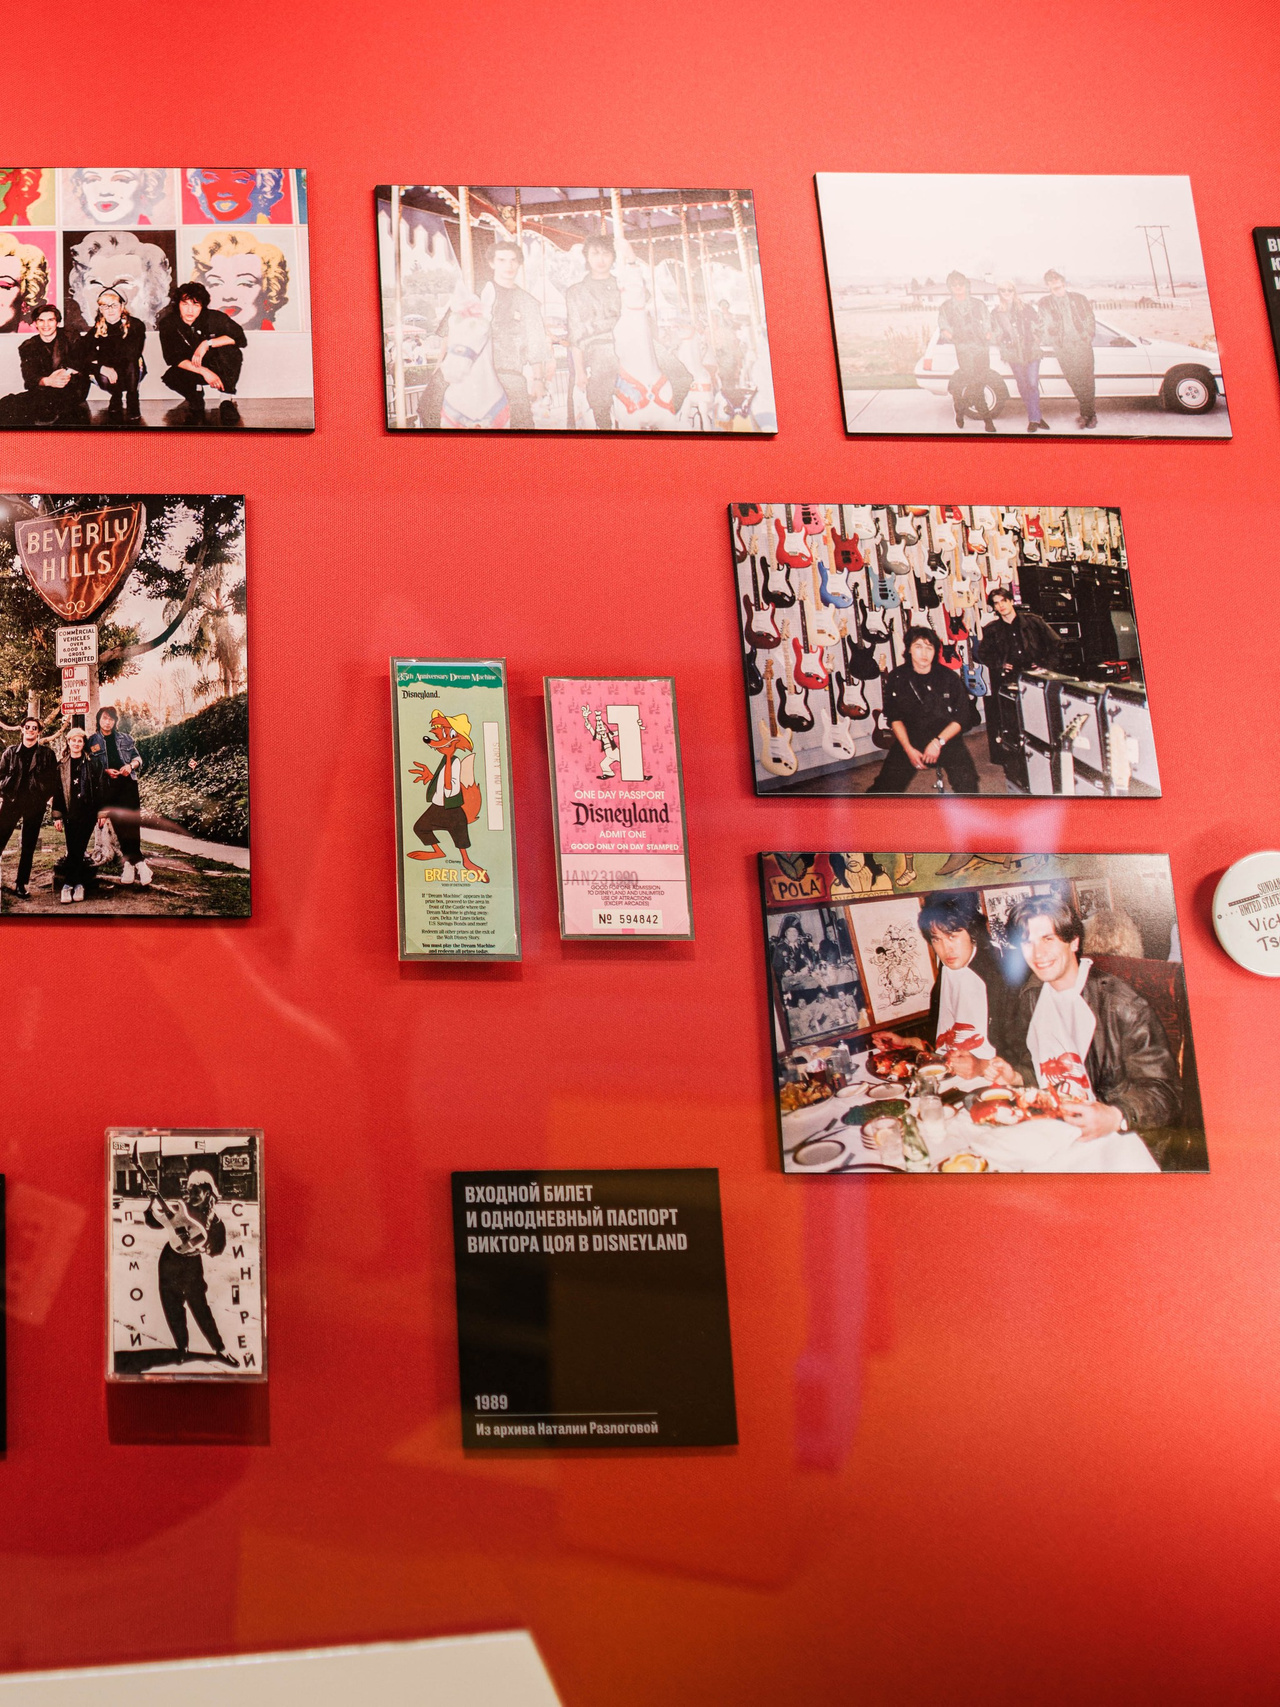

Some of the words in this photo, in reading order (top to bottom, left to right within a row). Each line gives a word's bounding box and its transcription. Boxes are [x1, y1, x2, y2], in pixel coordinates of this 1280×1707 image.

[27, 517, 129, 554] BEVERLY
[42, 550, 112, 582] HILLS
[64, 668, 73, 678] NO
[450, 673, 470, 681] Dream
[64, 680, 87, 688] STOPPING
[606, 704, 645, 782] 1
[574, 790, 596, 799] ONE
[597, 790, 616, 799] DAY
[619, 790, 665, 800] PASSPORT
[570, 801, 670, 828] Disneyland
[425, 868, 458, 882] BRER
[460, 869, 487, 882] FOX
[1238, 900, 1262, 916] UNITED
[620, 914, 658, 924] 594842
[1257, 936, 1280, 951] Ts
[465, 1182, 540, 1205] ВХОДНОЙ
[543, 1185, 593, 1202] БИЛЕТ
[466, 1211, 477, 1228] И
[480, 1206, 603, 1229] ОДНОДНЕВНЫЙ
[606, 1208, 678, 1227] ПАСПОРТ
[467, 1235, 540, 1253] ВИКТОРА
[543, 1235, 575, 1254] ЦОЯ
[579, 1234, 588, 1252] В
[592, 1233, 688, 1252] DISNEYLAND
[474, 1394, 508, 1411] 1989
[476, 1423, 491, 1436] Из
[493, 1424, 535, 1437] архива
[537, 1422, 587, 1435] Наталии
[589, 1420, 658, 1434] Разлоговой
